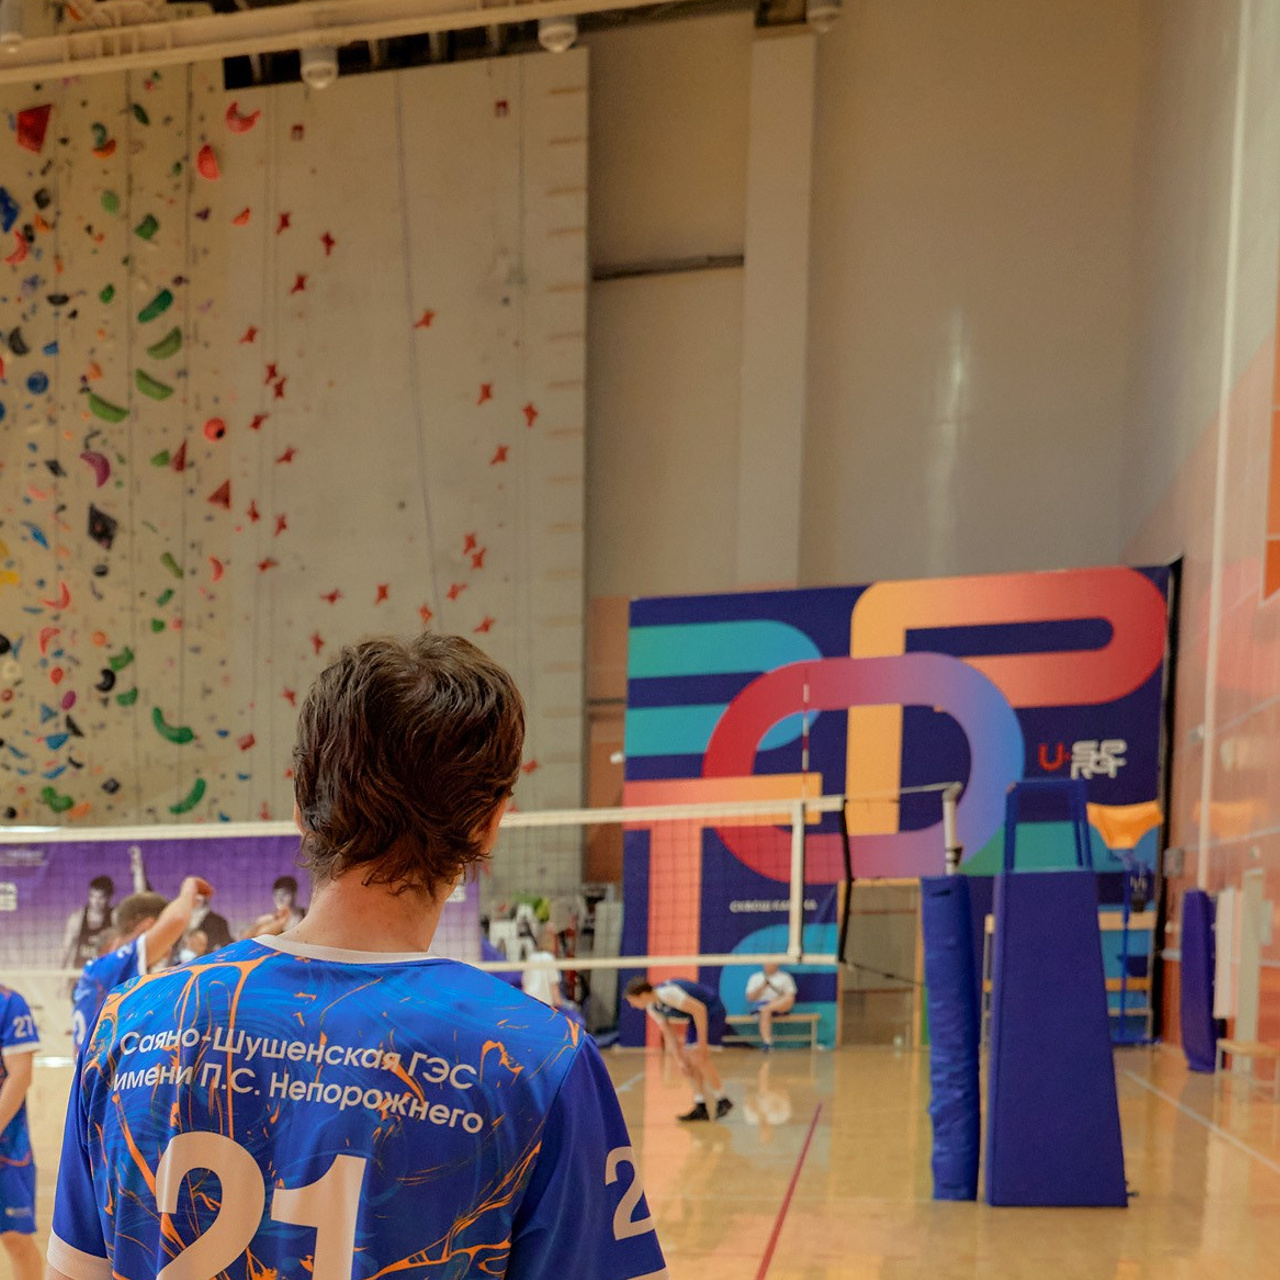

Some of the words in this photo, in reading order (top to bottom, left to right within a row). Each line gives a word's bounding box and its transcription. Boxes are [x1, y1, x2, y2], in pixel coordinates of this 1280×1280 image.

[120, 1026, 402, 1071] Саяно-Шушенская
[407, 1051, 477, 1090] ГЭС
[112, 1065, 195, 1092] имени
[200, 1062, 261, 1096] П.С.
[269, 1071, 484, 1134] Непорожнего
